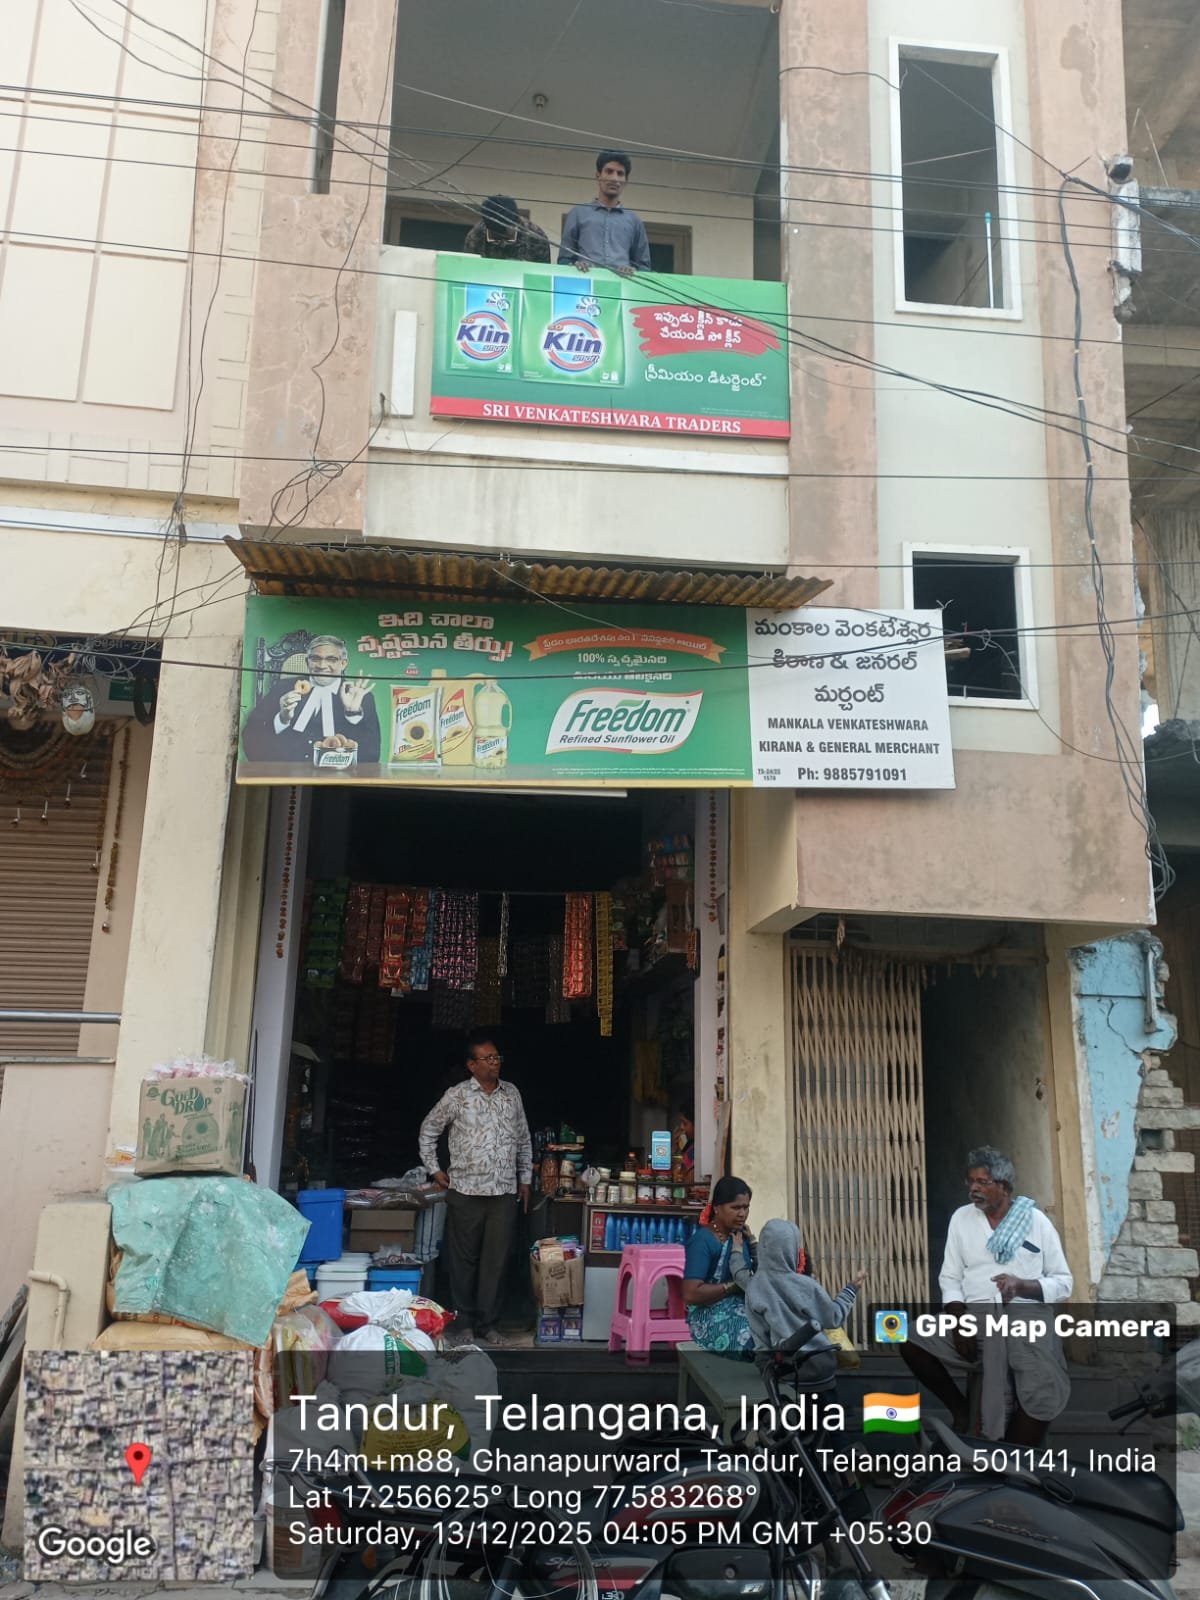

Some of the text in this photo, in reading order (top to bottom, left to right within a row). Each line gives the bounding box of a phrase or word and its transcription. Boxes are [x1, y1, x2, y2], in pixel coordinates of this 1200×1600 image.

[457, 324, 510, 344] Klin
[543, 331, 602, 354] Klin
[645, 363, 704, 383] ప్రీమియం
[483, 403, 741, 433] SRI VENKATESHWARA TRADERS
[378, 612, 494, 630] ఇది చాలా
[754, 617, 932, 644] మంకాల వెంకటేశ్వర
[357, 632, 448, 659] స్పష్టమైన
[577, 653, 605, 664] 100%
[830, 654, 848, 669] &
[855, 651, 918, 670] జనరల్
[814, 684, 885, 710] మర్చంట్
[395, 697, 431, 724] Freedom
[565, 699, 687, 733] Freedom
[768, 718, 928, 731] MANKALA VENKATESHWARA
[559, 734, 676, 744] Refined Sunflower Oil
[759, 741, 940, 755] KIRANA & GENERAL MERCHANT
[798, 768, 907, 781] Ph: 9885791091
